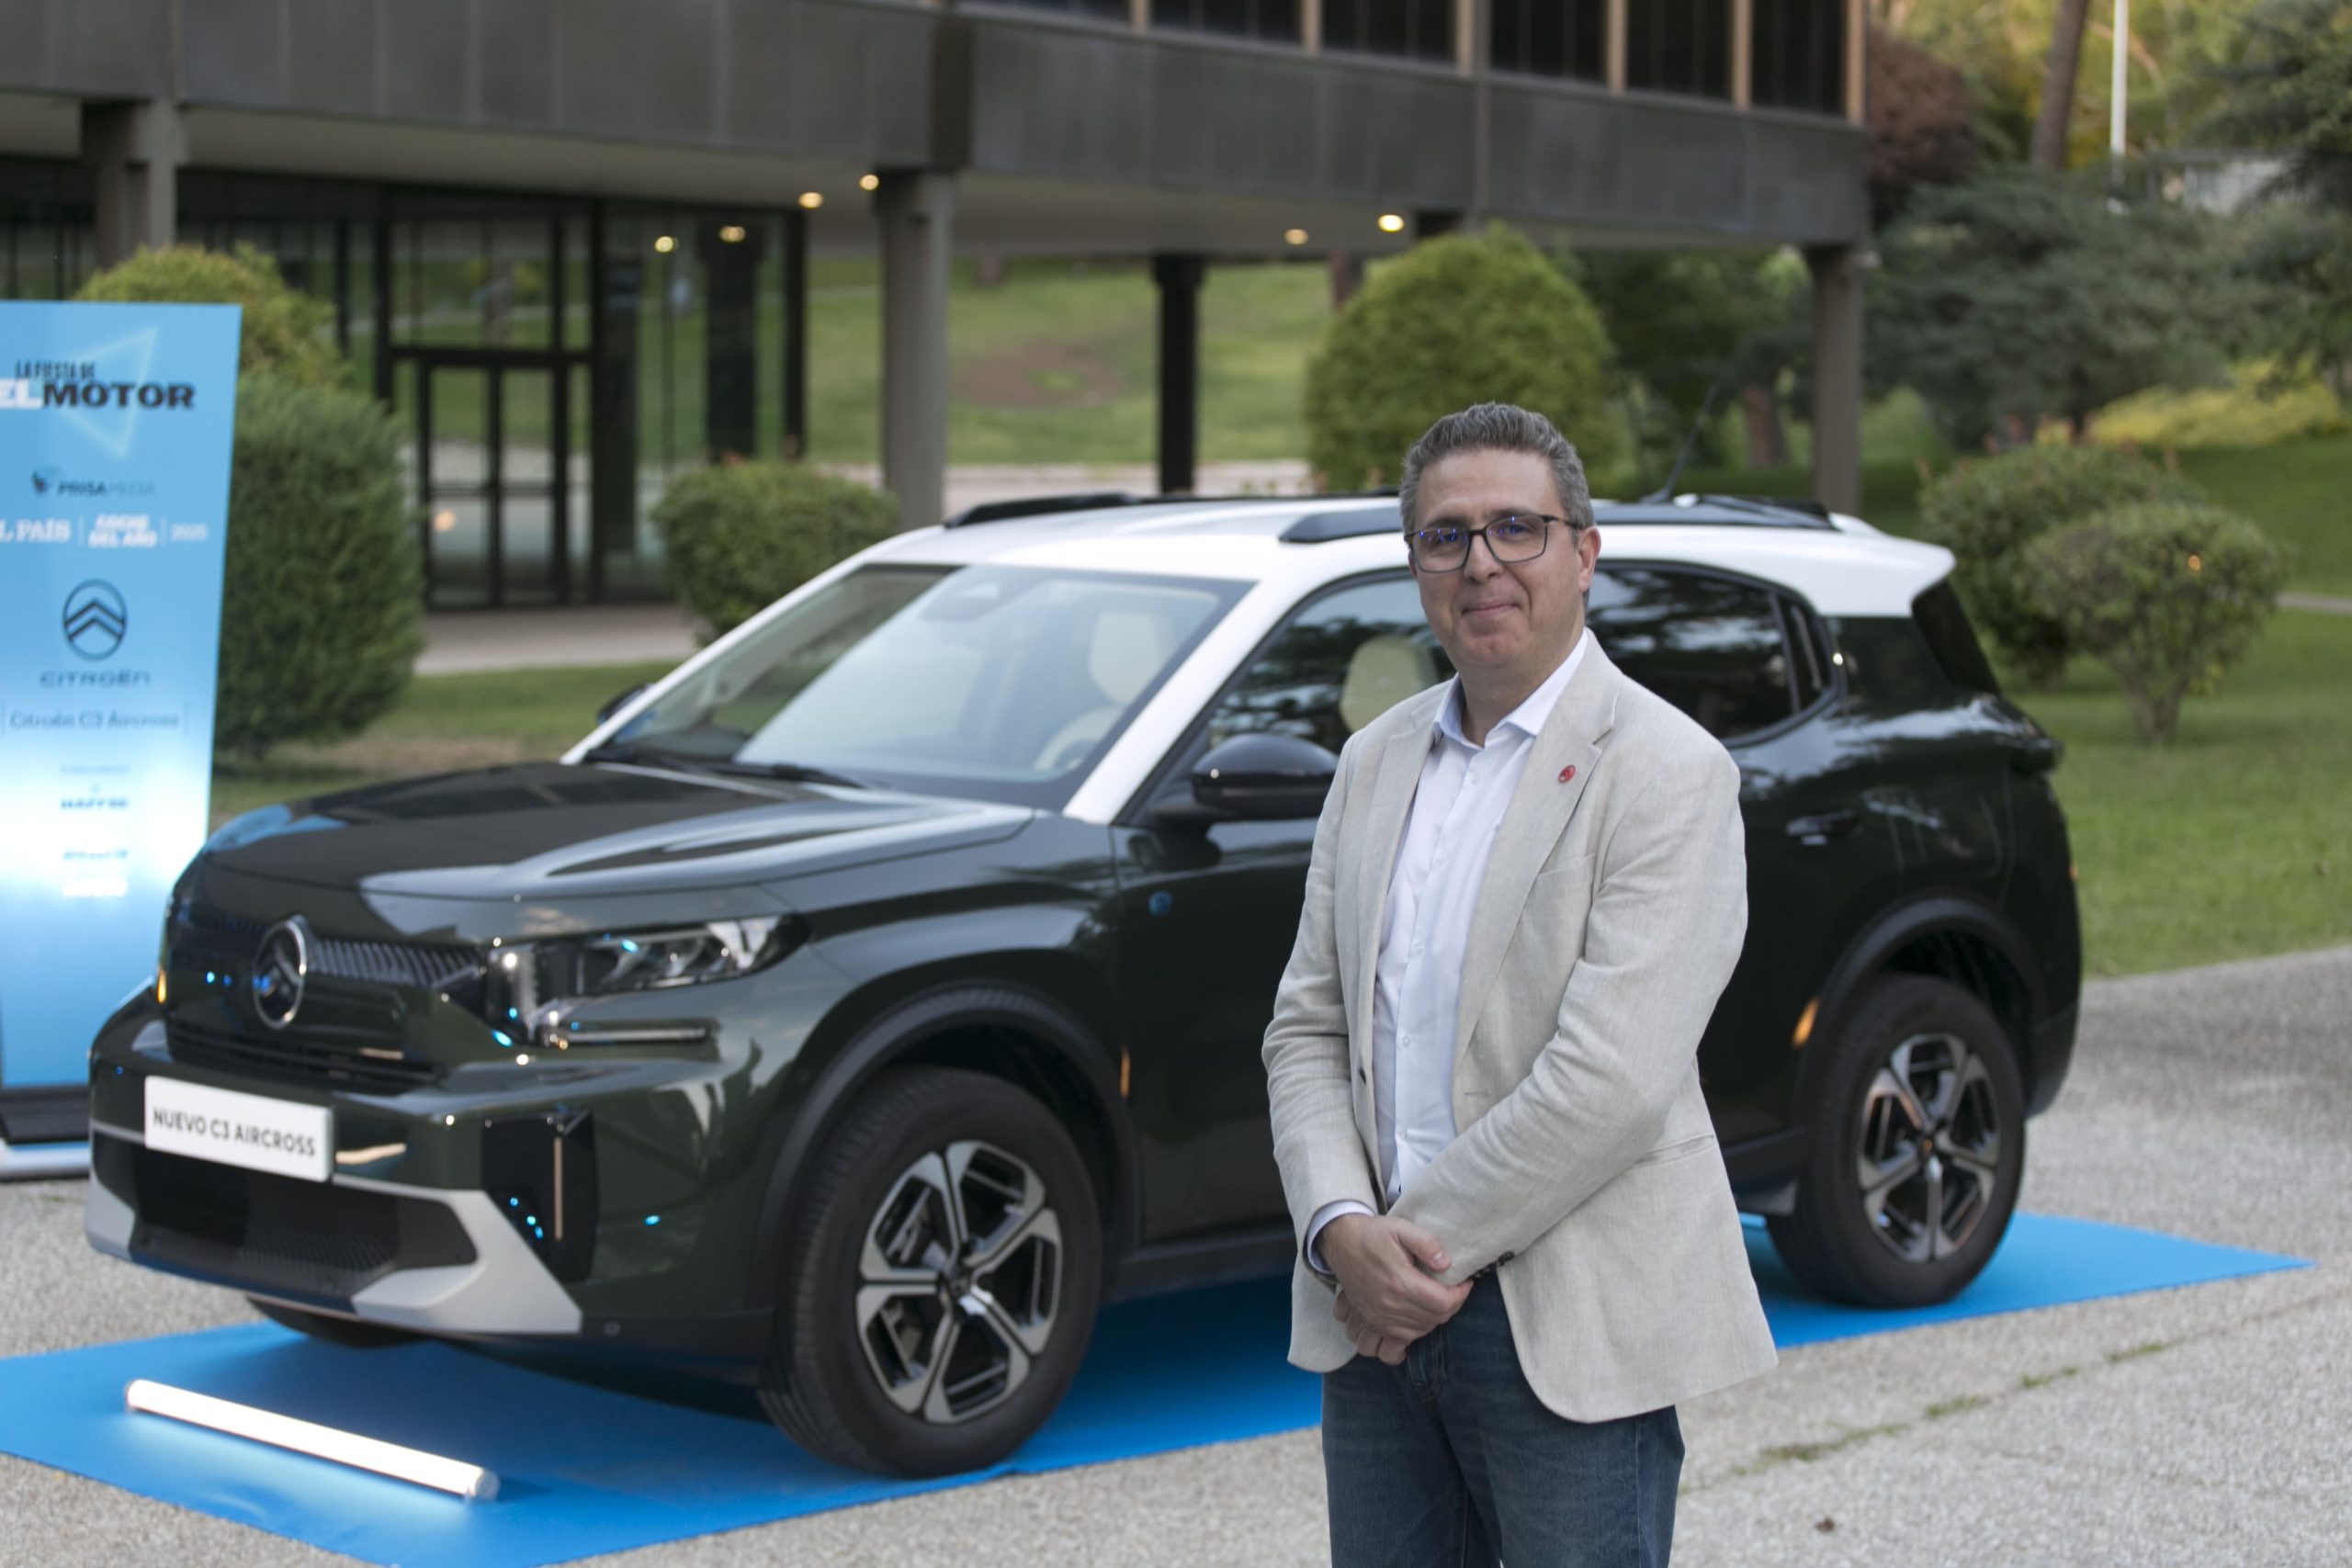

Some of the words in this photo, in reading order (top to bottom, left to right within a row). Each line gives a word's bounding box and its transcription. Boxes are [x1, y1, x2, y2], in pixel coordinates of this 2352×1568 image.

[153, 1107, 207, 1136] NUEVO
[209, 1119, 230, 1141] C3
[234, 1124, 316, 1157] AIRCROSS
